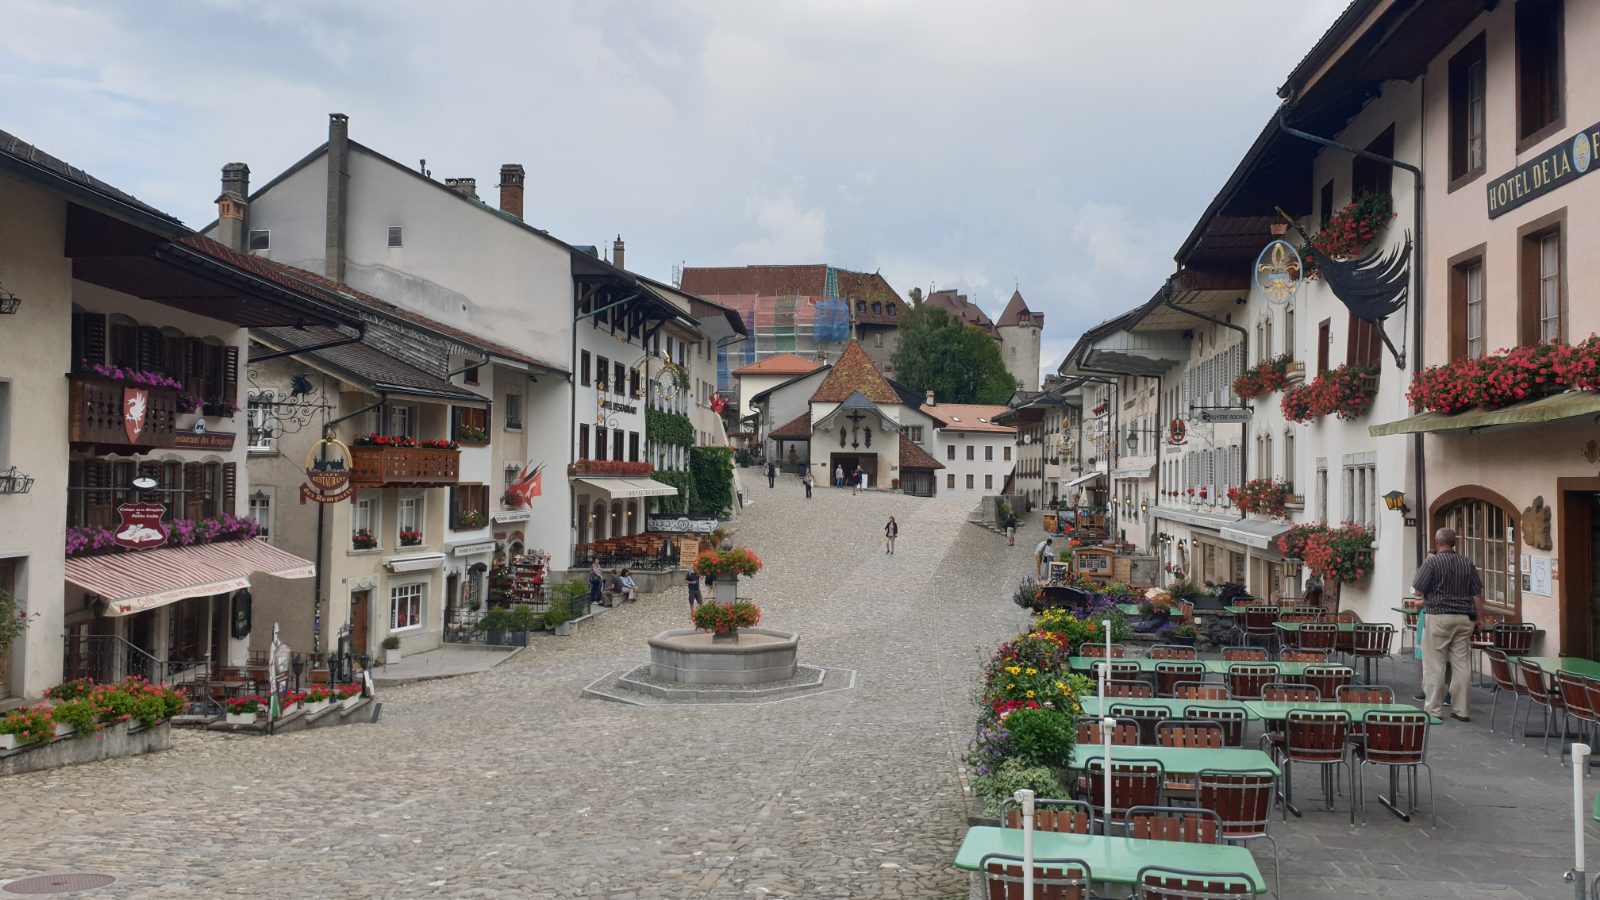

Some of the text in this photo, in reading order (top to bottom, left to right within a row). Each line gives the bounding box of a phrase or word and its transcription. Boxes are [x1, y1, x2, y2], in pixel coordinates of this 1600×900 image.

[1489, 171, 1531, 210] HOTEL
[1532, 159, 1551, 190] DE
[1552, 149, 1572, 180] LA
[613, 402, 637, 414] RESTAURANT
[175, 434, 200, 444] estaurant
[312, 476, 347, 487] RESTAURANT
[316, 488, 354, 502] Remparts
